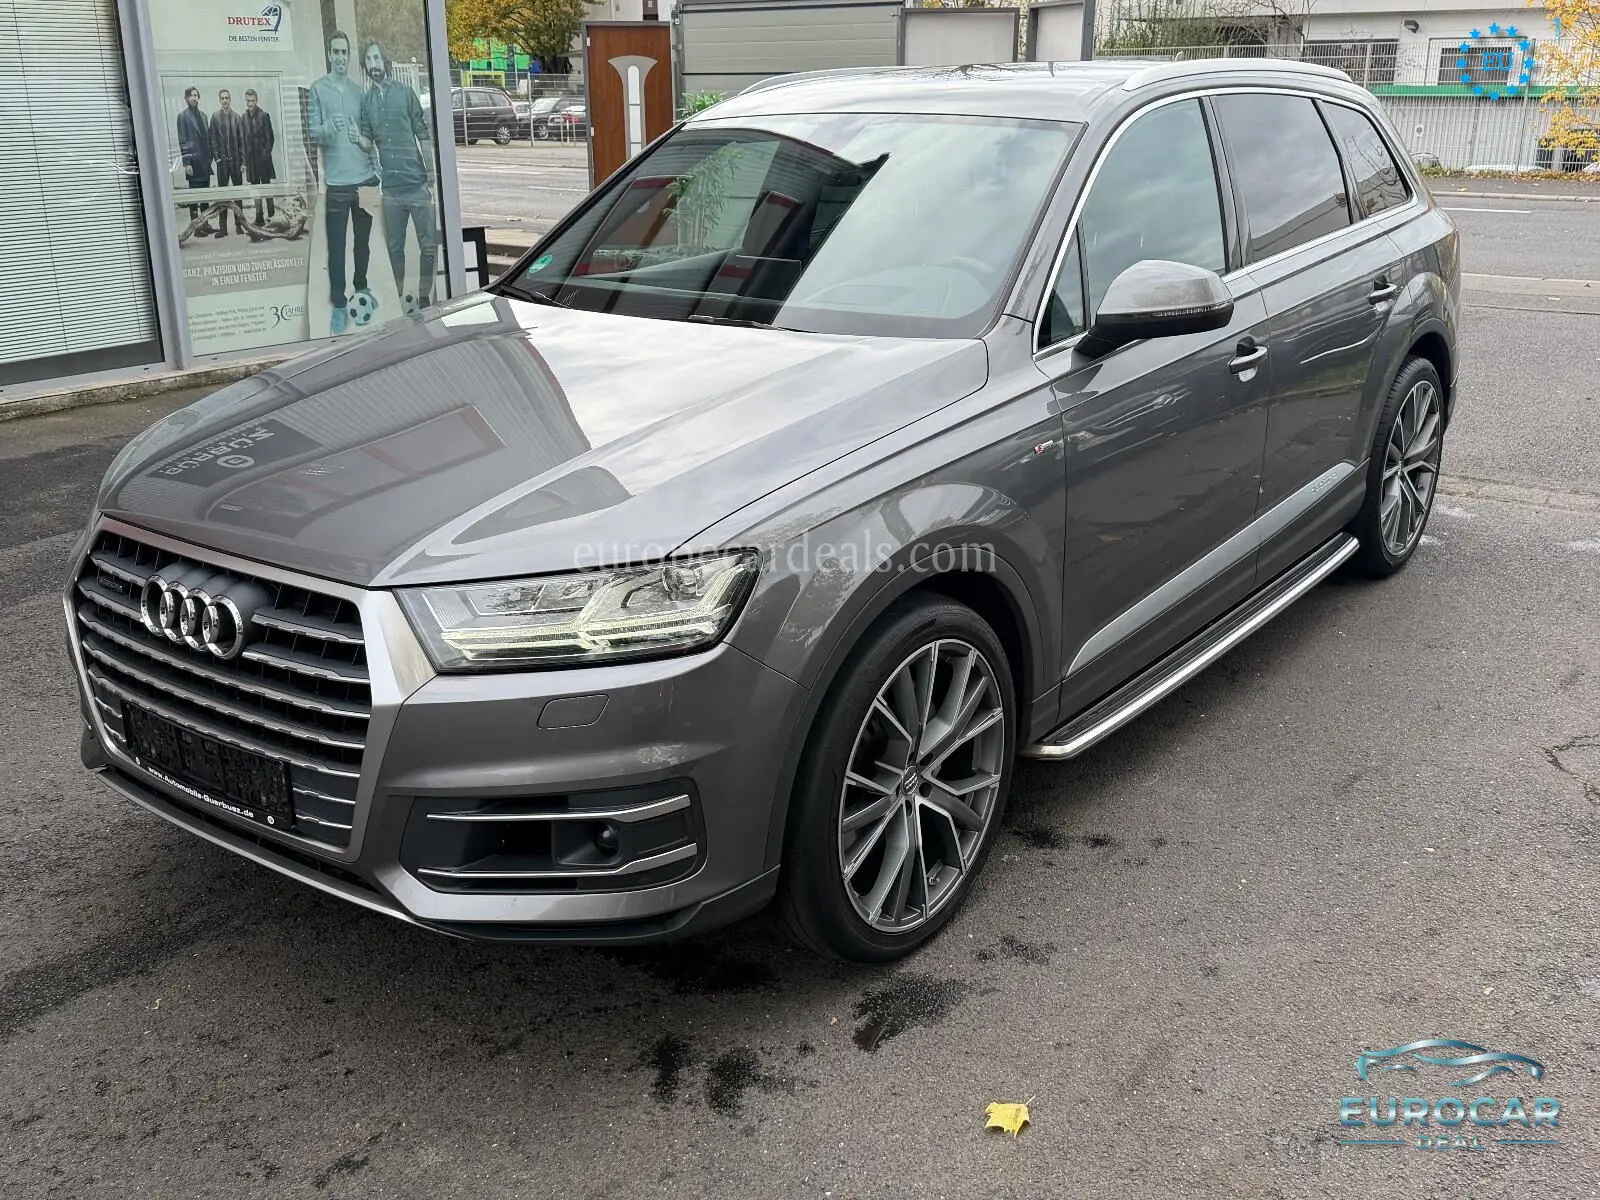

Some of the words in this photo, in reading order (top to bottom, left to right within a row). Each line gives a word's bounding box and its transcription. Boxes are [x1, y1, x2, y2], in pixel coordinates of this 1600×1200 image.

[227, 16, 271, 26] DRUTEX
[203, 263, 237, 277] PRÄZISION
[237, 262, 251, 273] UND
[211, 276, 219, 287] IN
[219, 274, 240, 286] EINEM
[240, 271, 268, 284] FENSTER
